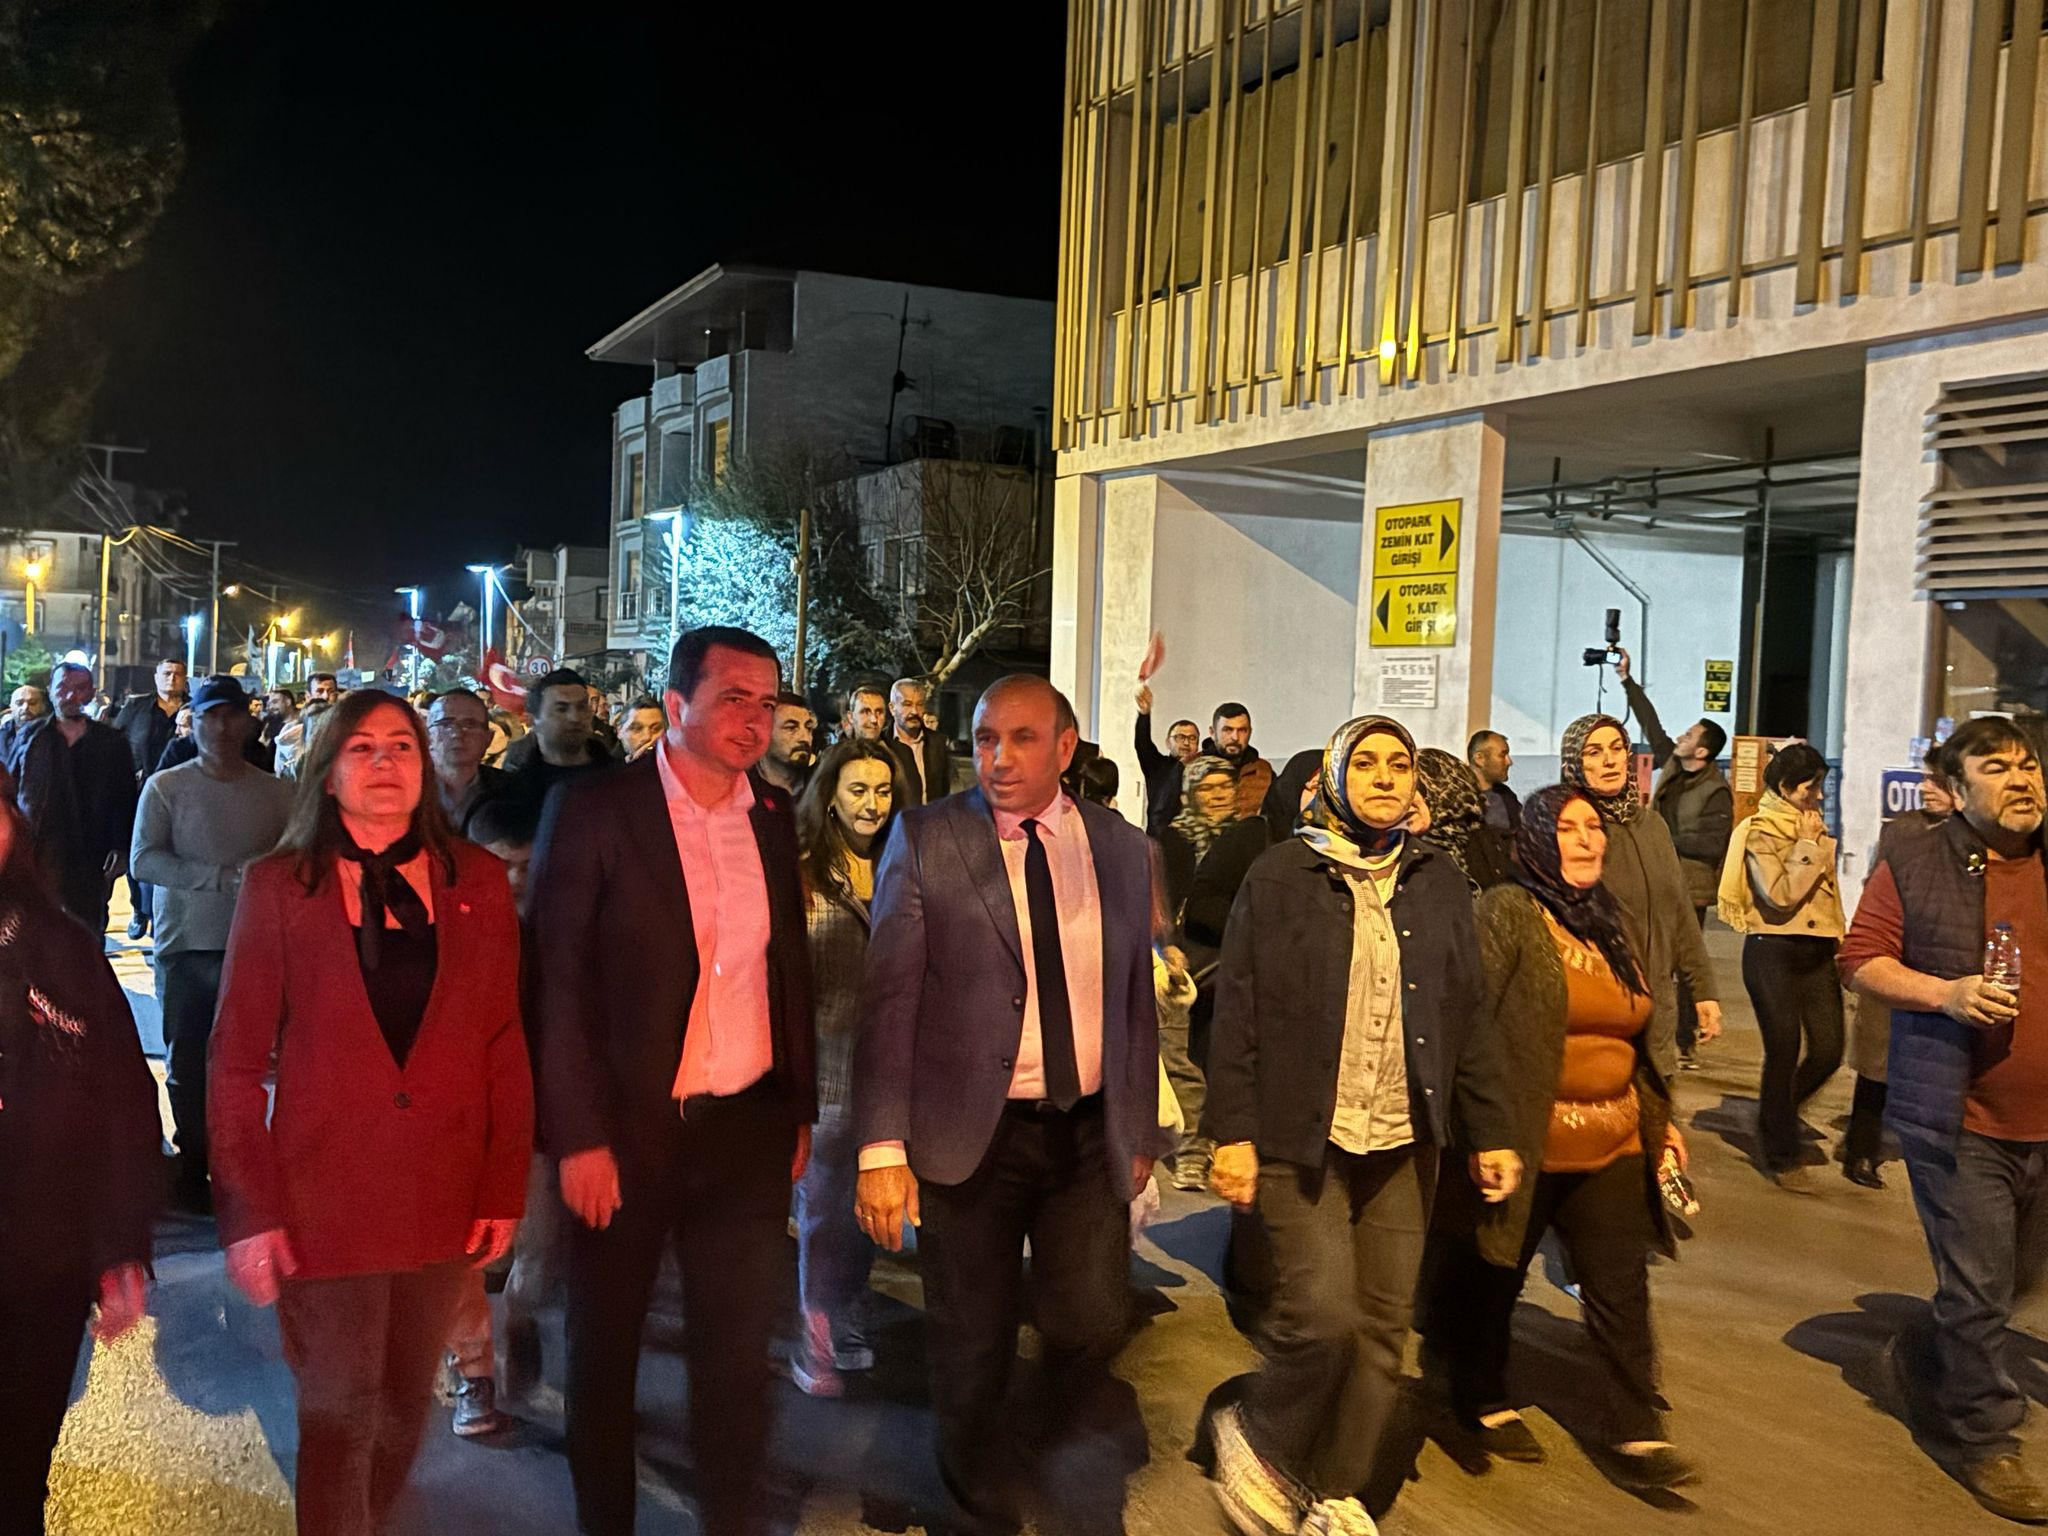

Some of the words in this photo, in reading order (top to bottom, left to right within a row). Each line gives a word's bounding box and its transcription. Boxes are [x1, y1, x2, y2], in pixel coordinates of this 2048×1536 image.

[1384, 514, 1433, 531] OTOPARK
[1381, 532, 1412, 549] ZEMİN
[1414, 532, 1435, 546] KAT
[1391, 549, 1422, 568] GİRİŞİ
[1399, 583, 1448, 597] OTOPARK
[1406, 602, 1415, 615] 1.
[1418, 602, 1438, 615] KAT
[531, 662, 548, 675] 30
